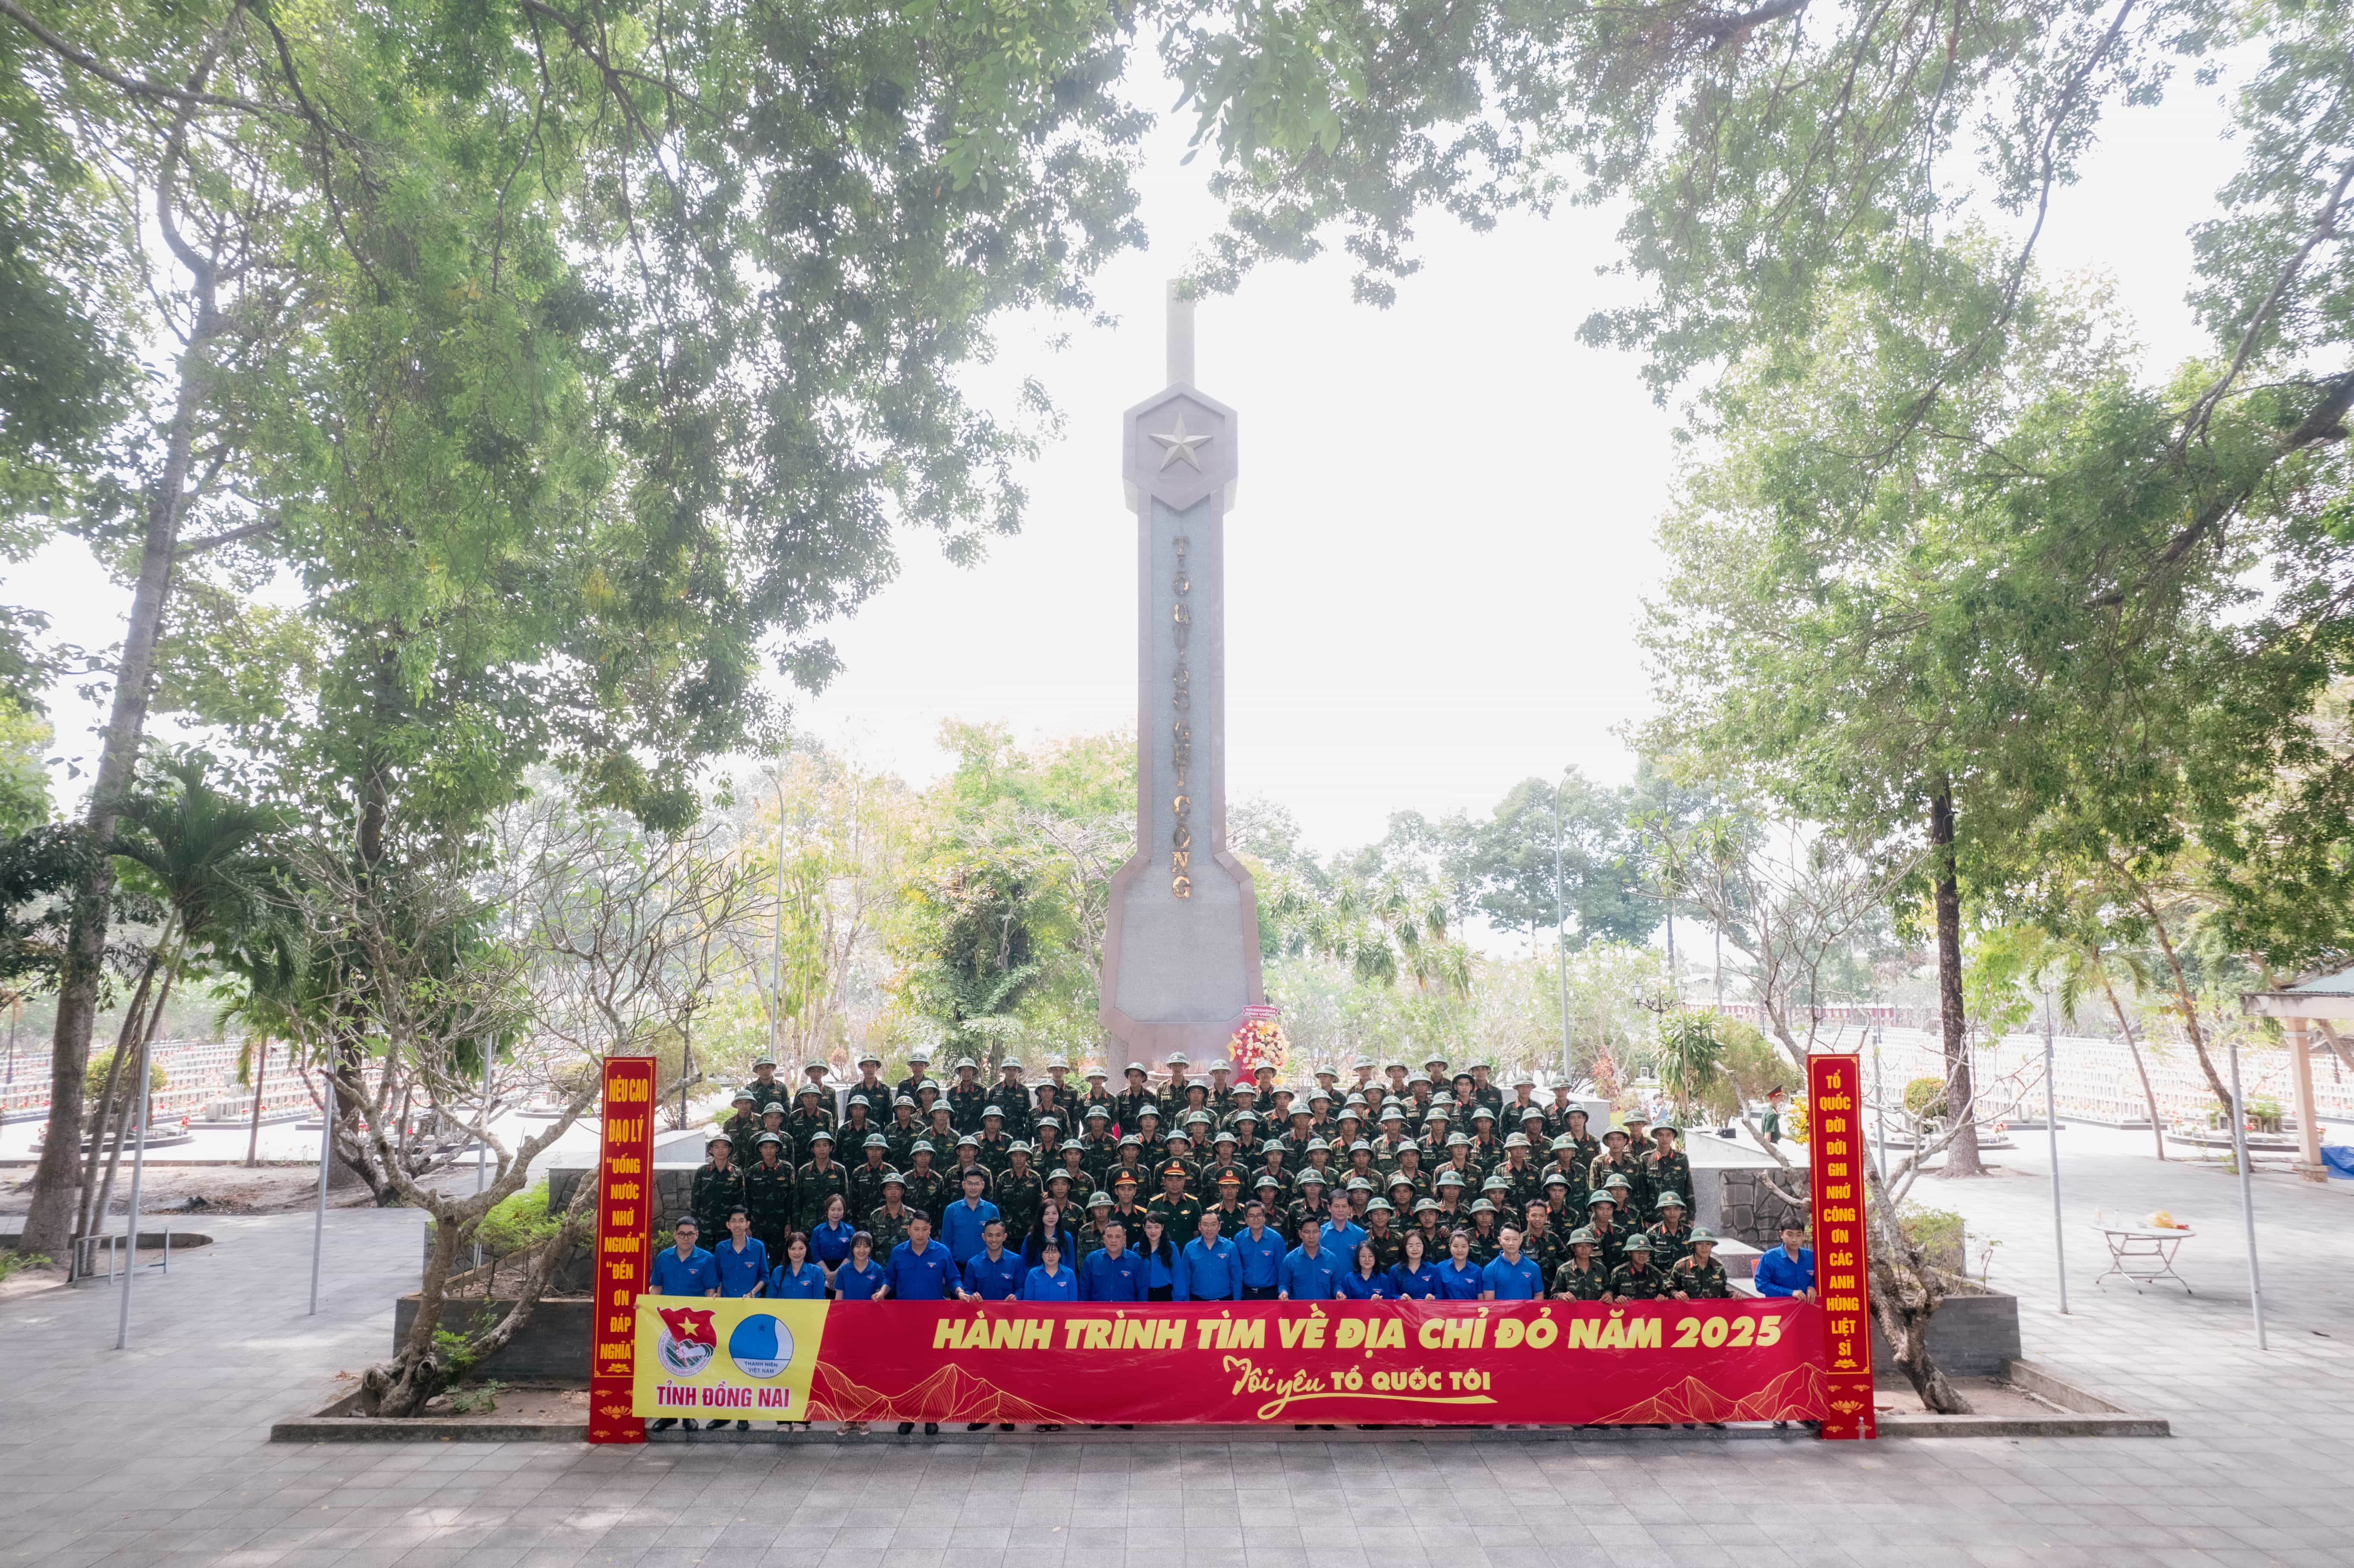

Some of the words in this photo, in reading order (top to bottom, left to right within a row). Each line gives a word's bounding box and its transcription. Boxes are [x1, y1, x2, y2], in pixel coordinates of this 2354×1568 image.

[1172, 720, 1191, 787] GHI
[1172, 795, 1191, 899] CÔNG
[608, 1074, 628, 1102] NÊU
[629, 1078, 648, 1102] CAO
[1826, 1069, 1841, 1089] TỔ
[1820, 1091, 1851, 1111] QUỐC
[608, 1119, 629, 1146] ĐẠO
[631, 1114, 644, 1142] LÝ
[1826, 1116, 1845, 1132] ĐỜI
[1826, 1138, 1846, 1155] ĐỜI
[1828, 1163, 1847, 1176] GHI
[611, 1181, 639, 1200] NƯỚC
[1826, 1182, 1851, 1199] NHỚ
[612, 1207, 635, 1226] NHỚ
[1824, 1206, 1855, 1222] CÔNG
[1831, 1229, 1848, 1243] ƠN
[1829, 1250, 1853, 1266] CÁC
[1829, 1275, 1854, 1289] ANH
[613, 1289, 629, 1306] ƠN
[1826, 1295, 1859, 1311] HÙNG
[610, 1313, 632, 1332] ĐÁP
[933, 1310, 1054, 1349] HÀNH
[1065, 1310, 1186, 1349] TRÌNH
[1197, 1310, 1265, 1349] TÌM
[1278, 1304, 1328, 1348] VỀ
[1336, 1318, 1406, 1358] ĐỊA
[1418, 1307, 1489, 1349] CHỈ
[1494, 1307, 1558, 1349] ĐỎ
[1569, 1309, 1661, 1348] NĂM
[1671, 1316, 1781, 1348] 2025
[1831, 1317, 1856, 1336] LIỆT
[1839, 1339, 1851, 1356] SĨ
[1331, 1364, 1363, 1390] TỔ
[1371, 1366, 1442, 1391] QUỐC
[1449, 1368, 1490, 1390] TÔI
[657, 1380, 696, 1405] TỈNH
[702, 1381, 752, 1407] ĐỒNG
[758, 1388, 789, 1407] NAI
